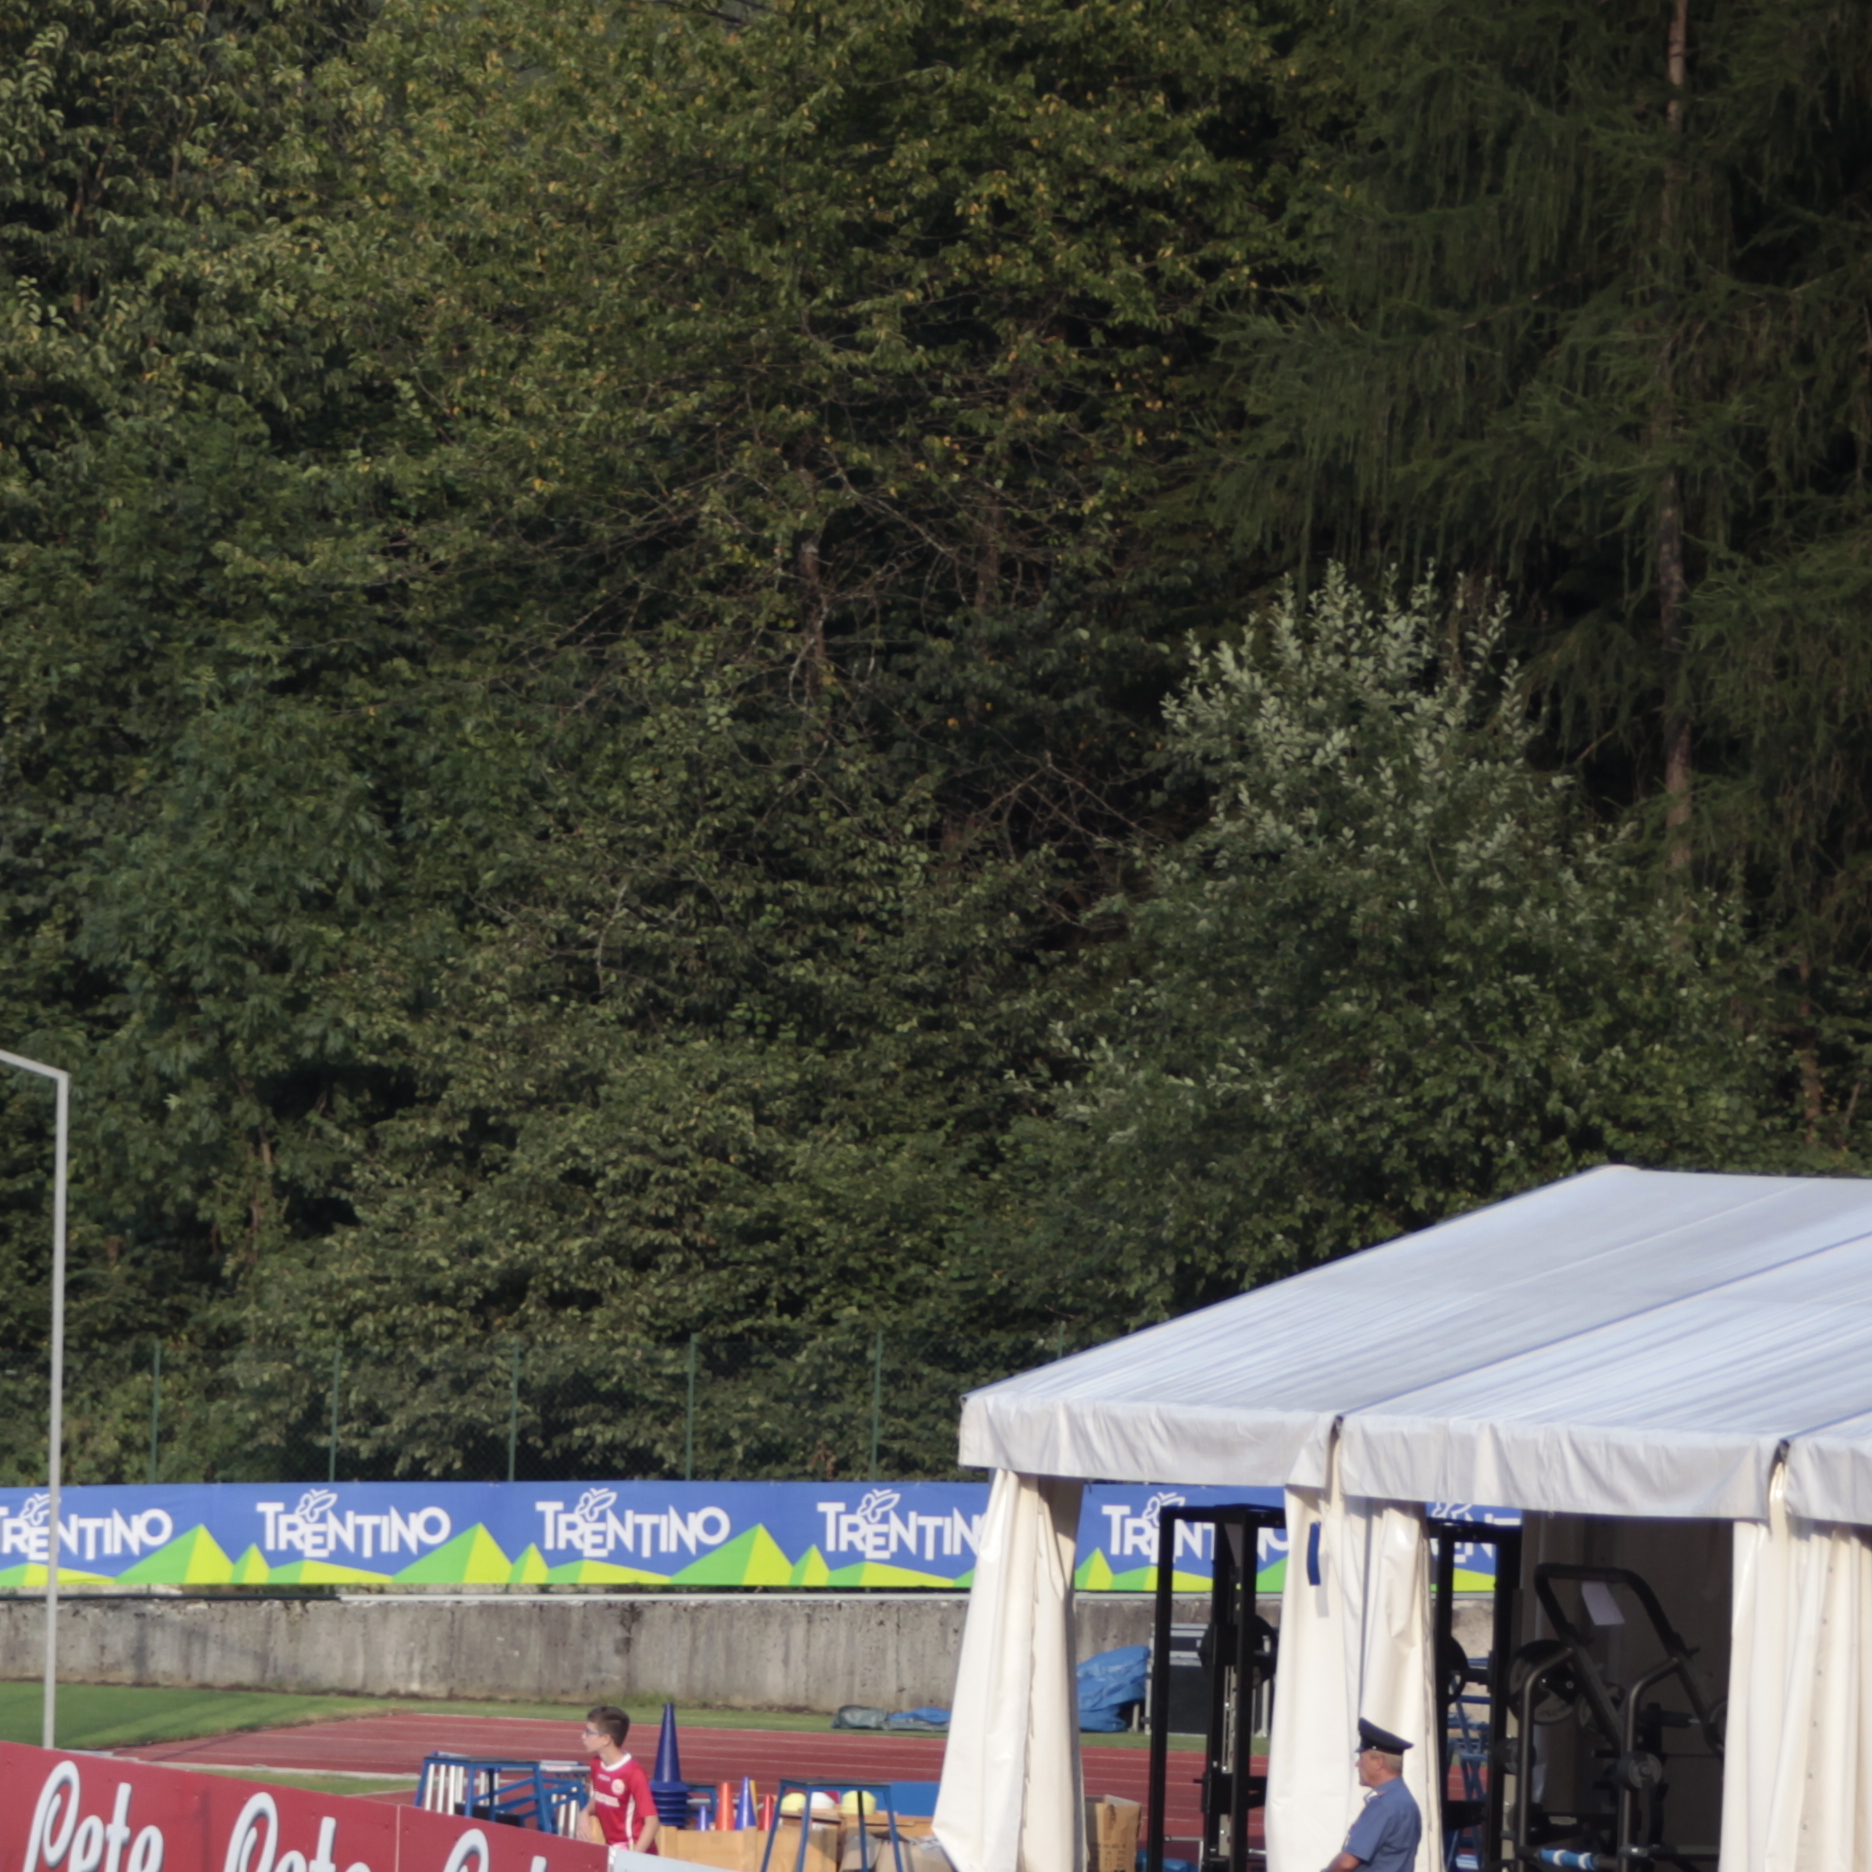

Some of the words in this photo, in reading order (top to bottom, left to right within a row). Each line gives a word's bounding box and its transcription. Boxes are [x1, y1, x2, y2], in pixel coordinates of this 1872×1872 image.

[257, 1502, 452, 1558] TRENTINO
[535, 1501, 731, 1558] TRENTINO
[817, 1502, 991, 1560] TRENTIN
